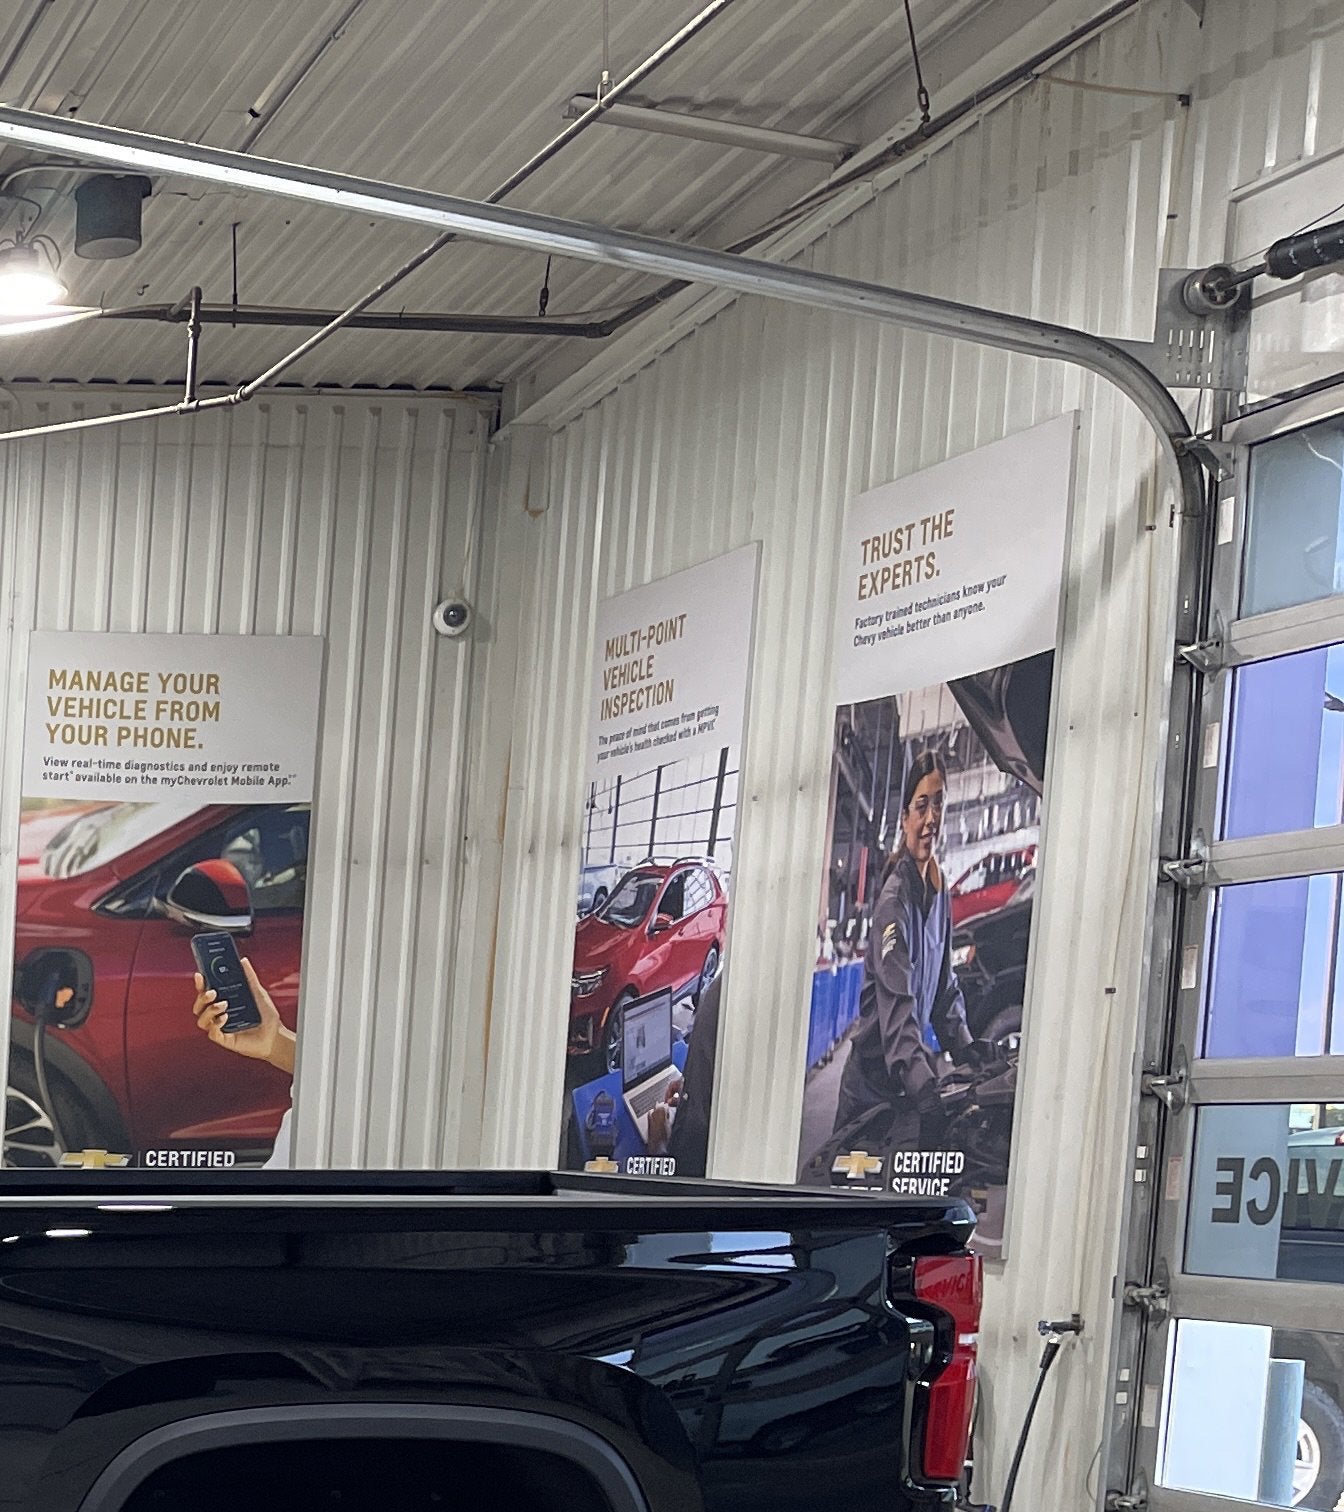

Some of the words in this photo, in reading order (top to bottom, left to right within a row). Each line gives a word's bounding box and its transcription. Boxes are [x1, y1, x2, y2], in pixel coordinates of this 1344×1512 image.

[860, 522, 916, 566] TRUST
[920, 509, 955, 546] THE
[858, 552, 940, 601] EXPERTS.
[855, 614, 883, 630] Factory
[885, 602, 913, 621] trained
[914, 591, 961, 613] technicians
[962, 582, 985, 598] know
[986, 574, 1007, 595] your
[604, 613, 688, 661] MULTI-POINT
[854, 634, 876, 648] Chevy
[878, 624, 904, 643] vehicle
[906, 618, 932, 635] better
[933, 611, 952, 627] than
[953, 602, 985, 622] anyone.
[49, 669, 149, 694] MANAGE
[158, 673, 220, 695] YOUR
[603, 654, 655, 691] VEHICLE
[47, 696, 146, 721] VEHICLE
[155, 700, 220, 722] FROM
[601, 679, 674, 721] INSPECTION
[681, 712, 695, 723] from
[45, 723, 108, 746] YOUR
[117, 727, 204, 749] PHONE.
[43, 756, 69, 767] View
[72, 758, 122, 769] real-time
[125, 760, 185, 773] diagnostics
[188, 762, 208, 771] and
[211, 762, 239, 774] enjoy
[242, 763, 281, 772] remote
[75, 772, 122, 783] available
[125, 775, 138, 784] on
[141, 774, 158, 785] the
[161, 775, 228, 788] myChevrolet
[231, 776, 265, 787] Mobile
[145, 1150, 236, 1168] CERTIFIED
[625, 1156, 677, 1176] CERTIFIED
[894, 1151, 965, 1175] CERTIFIED
[892, 1177, 951, 1197] SERVICE
